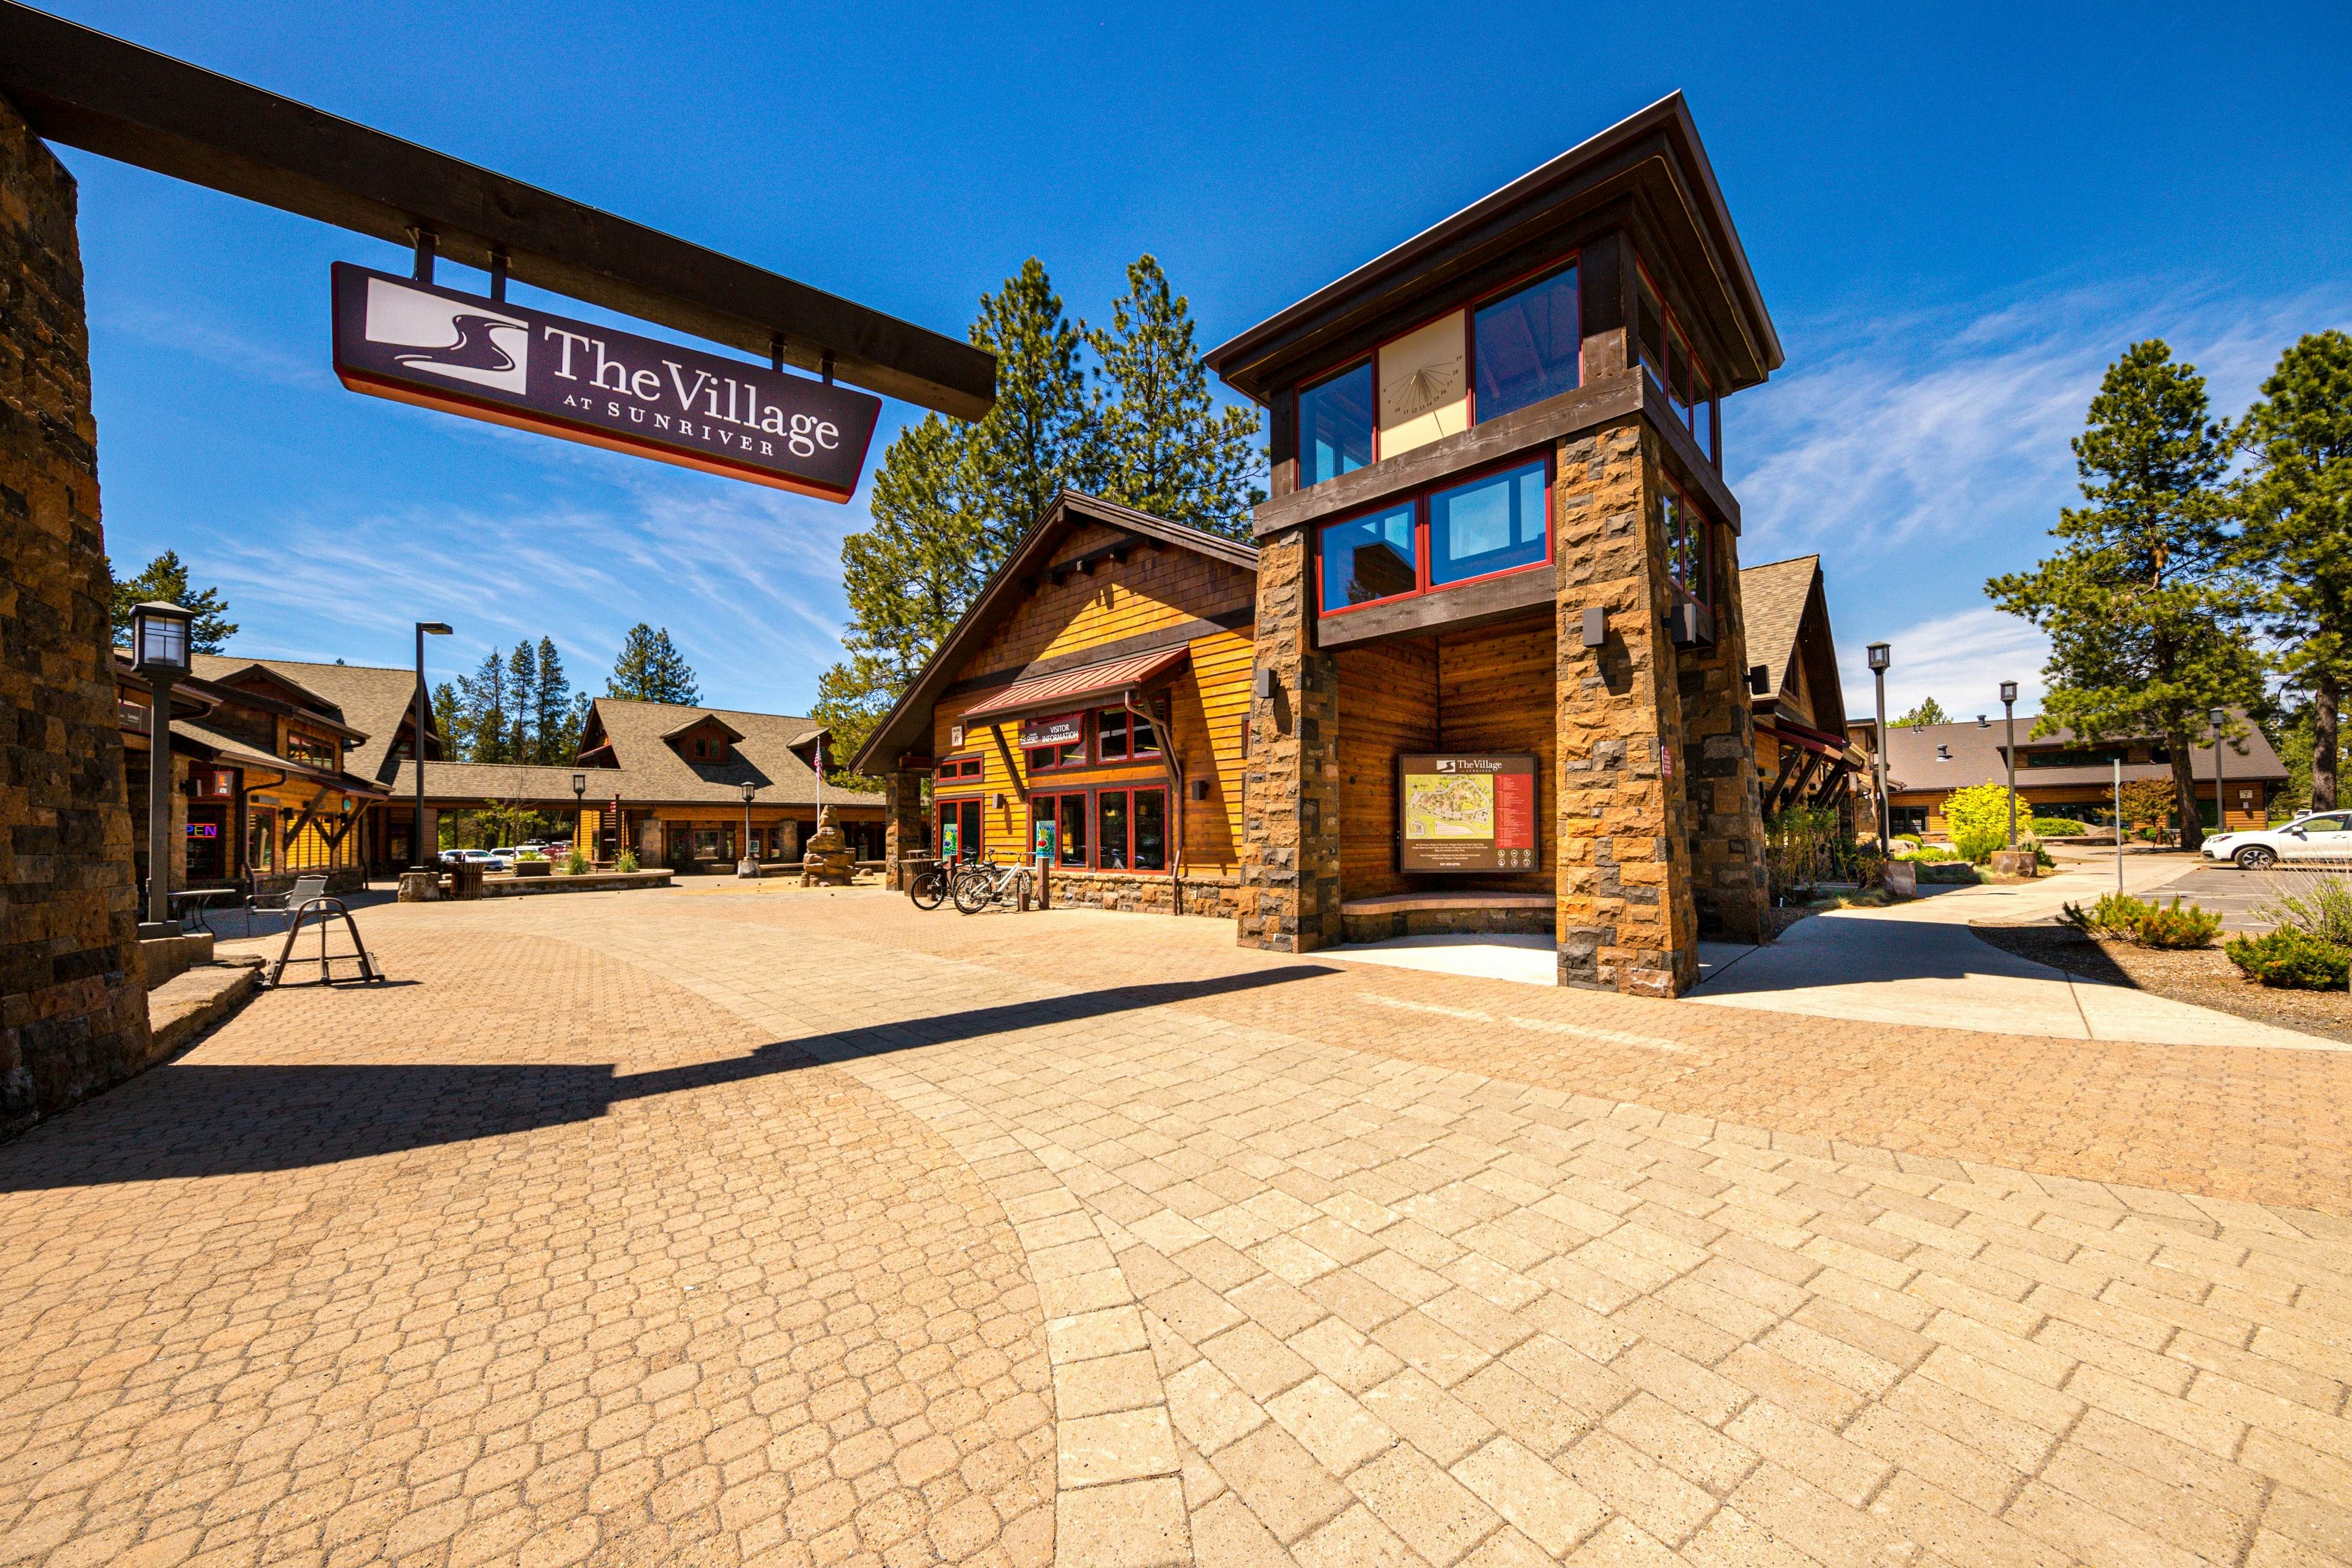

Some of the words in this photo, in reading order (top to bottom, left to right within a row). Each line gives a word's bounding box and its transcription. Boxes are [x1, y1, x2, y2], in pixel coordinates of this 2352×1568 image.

[545, 326, 660, 401] The
[662, 360, 839, 457] Village
[563, 394, 592, 410] AT
[608, 402, 774, 457] SUNRIVER
[1050, 724, 1070, 733] VISITOR
[1042, 730, 1079, 743] INFORMATION
[1458, 760, 1473, 768] The
[1473, 760, 1502, 771] Village
[186, 826, 217, 836] PEN
